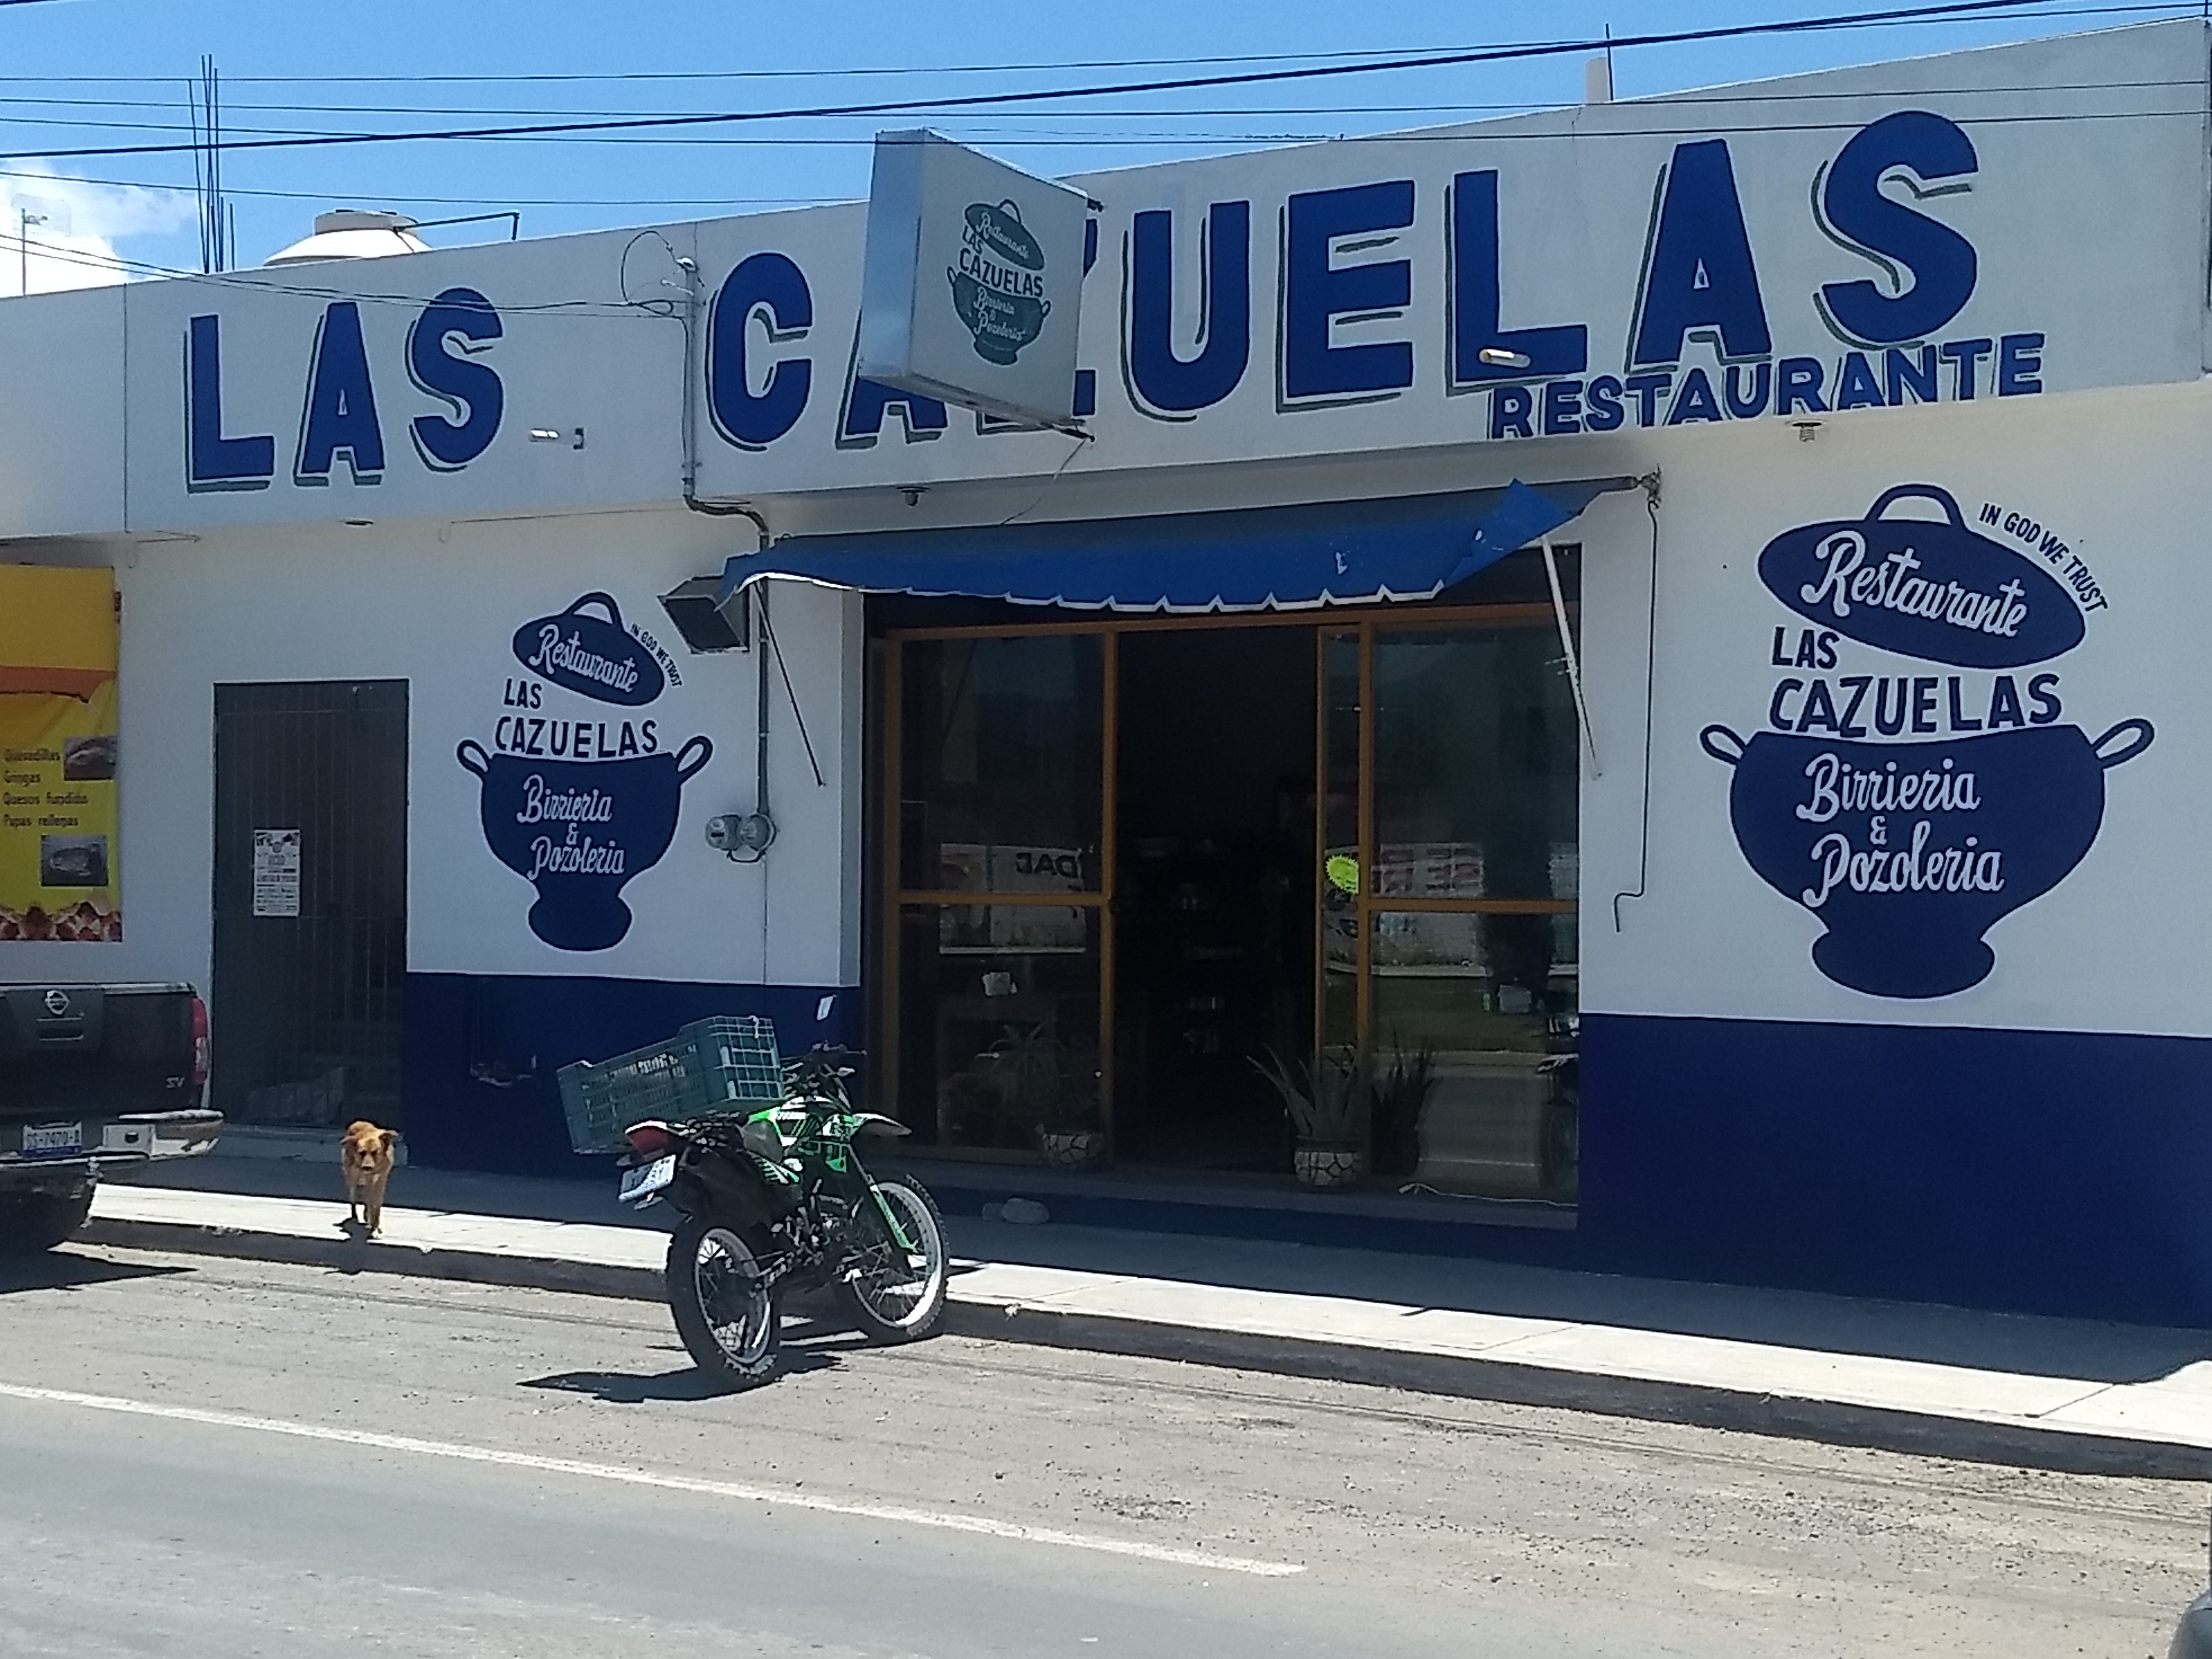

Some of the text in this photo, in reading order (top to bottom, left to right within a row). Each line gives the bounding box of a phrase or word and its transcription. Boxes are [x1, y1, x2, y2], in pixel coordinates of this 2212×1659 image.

[962, 225, 984, 255] LAS
[960, 247, 1043, 297] CAZUELAS
[184, 110, 1978, 493] LAS CUELAS
[1487, 332, 2047, 440] RESTAURANTE
[1979, 503, 2108, 612] IN GOD WE TRUST
[1800, 530, 2028, 636] Restaurante
[529, 624, 639, 693] Restaurante
[631, 623, 682, 686] IN GOD WE TRUST
[1771, 627, 1840, 669] LAS
[504, 678, 543, 709] LAS
[1769, 674, 2063, 737] CAZUELAS
[4, 748, 60, 762] Quesadillas
[495, 716, 658, 758] CAZUELAS
[4, 792, 40, 806] Quesos
[516, 774, 613, 823] Birrieria
[1796, 753, 1981, 822] Birrieria
[4, 813, 32, 829] Papas
[566, 822, 578, 845] &
[1870, 815, 1888, 845] &
[527, 836, 626, 880] Pozoleria
[1802, 821, 2005, 908] Pozoleria
[166, 1076, 185, 1088] SV
